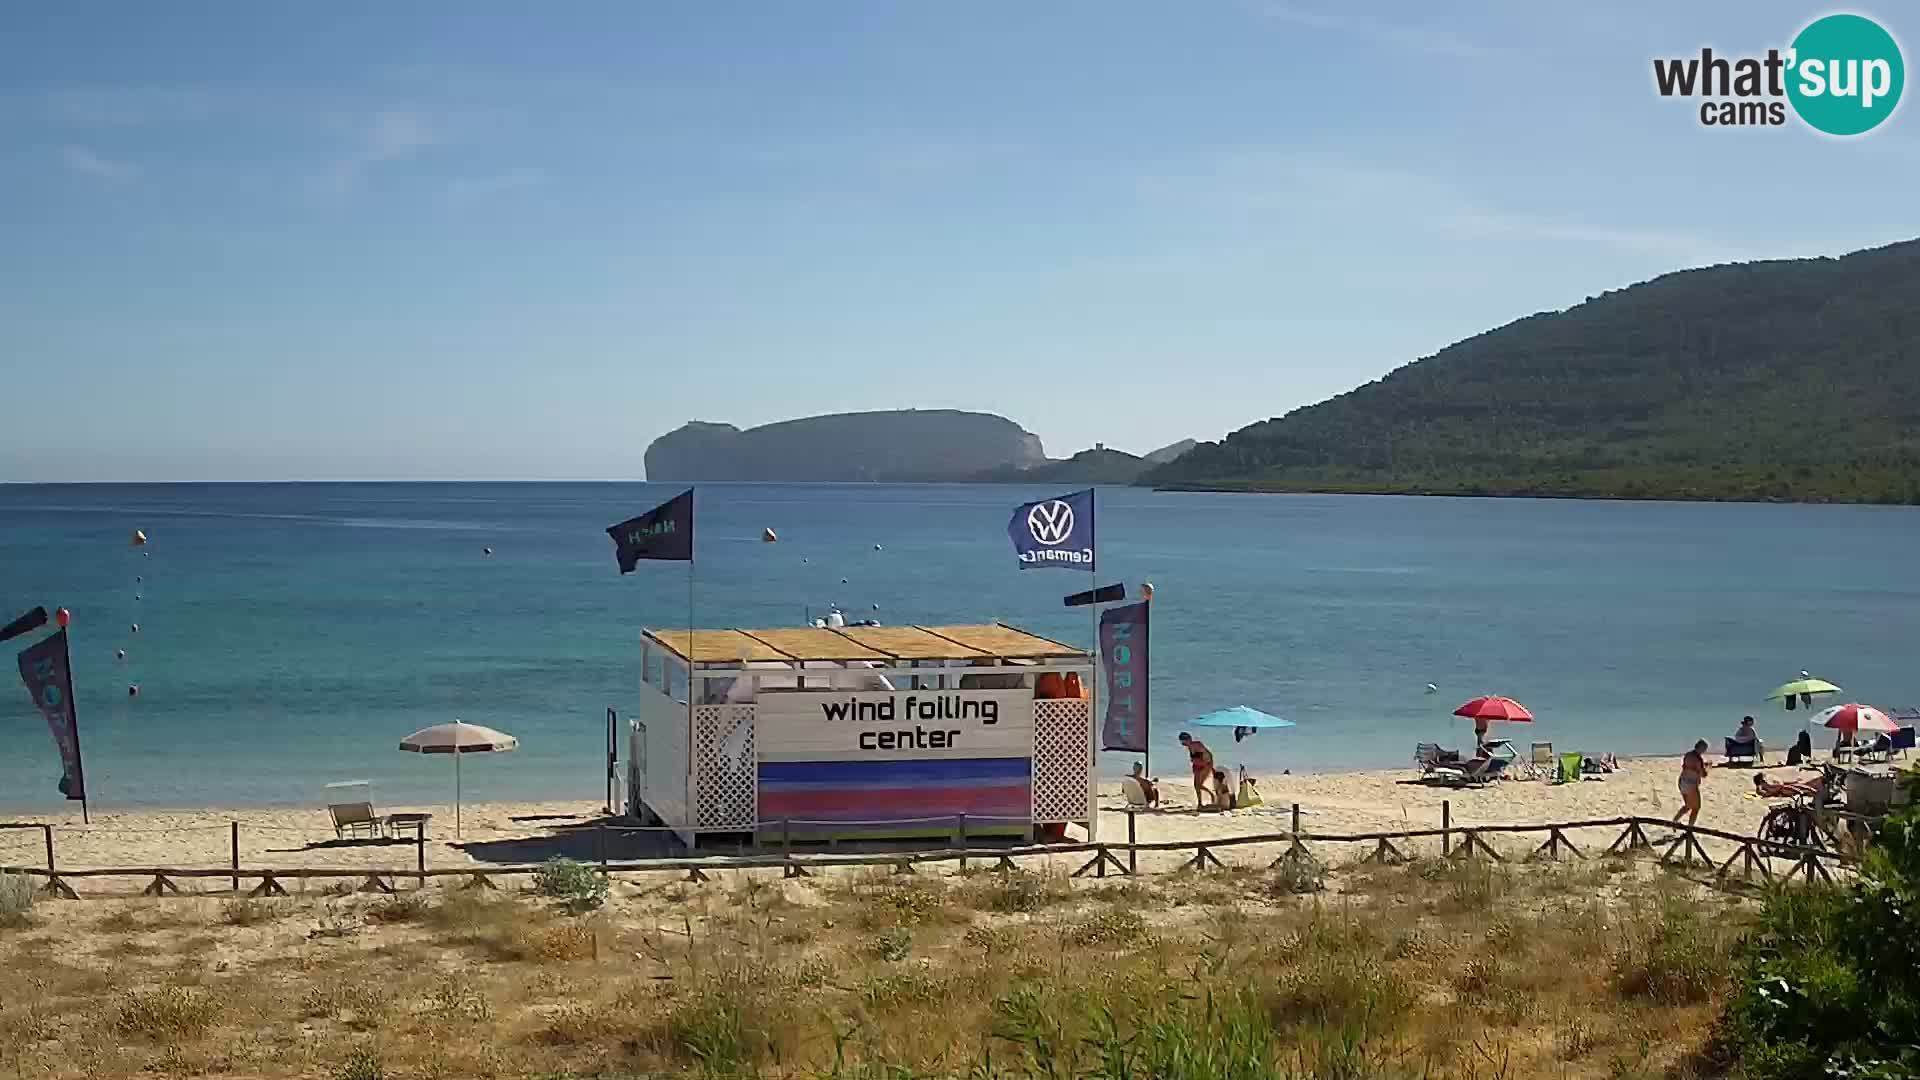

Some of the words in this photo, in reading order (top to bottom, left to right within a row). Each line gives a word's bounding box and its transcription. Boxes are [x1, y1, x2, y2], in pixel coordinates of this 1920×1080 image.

[1112, 622, 1134, 738] NORTH
[822, 697, 895, 720] wind
[905, 696, 998, 724] foiling
[859, 724, 960, 749] center
